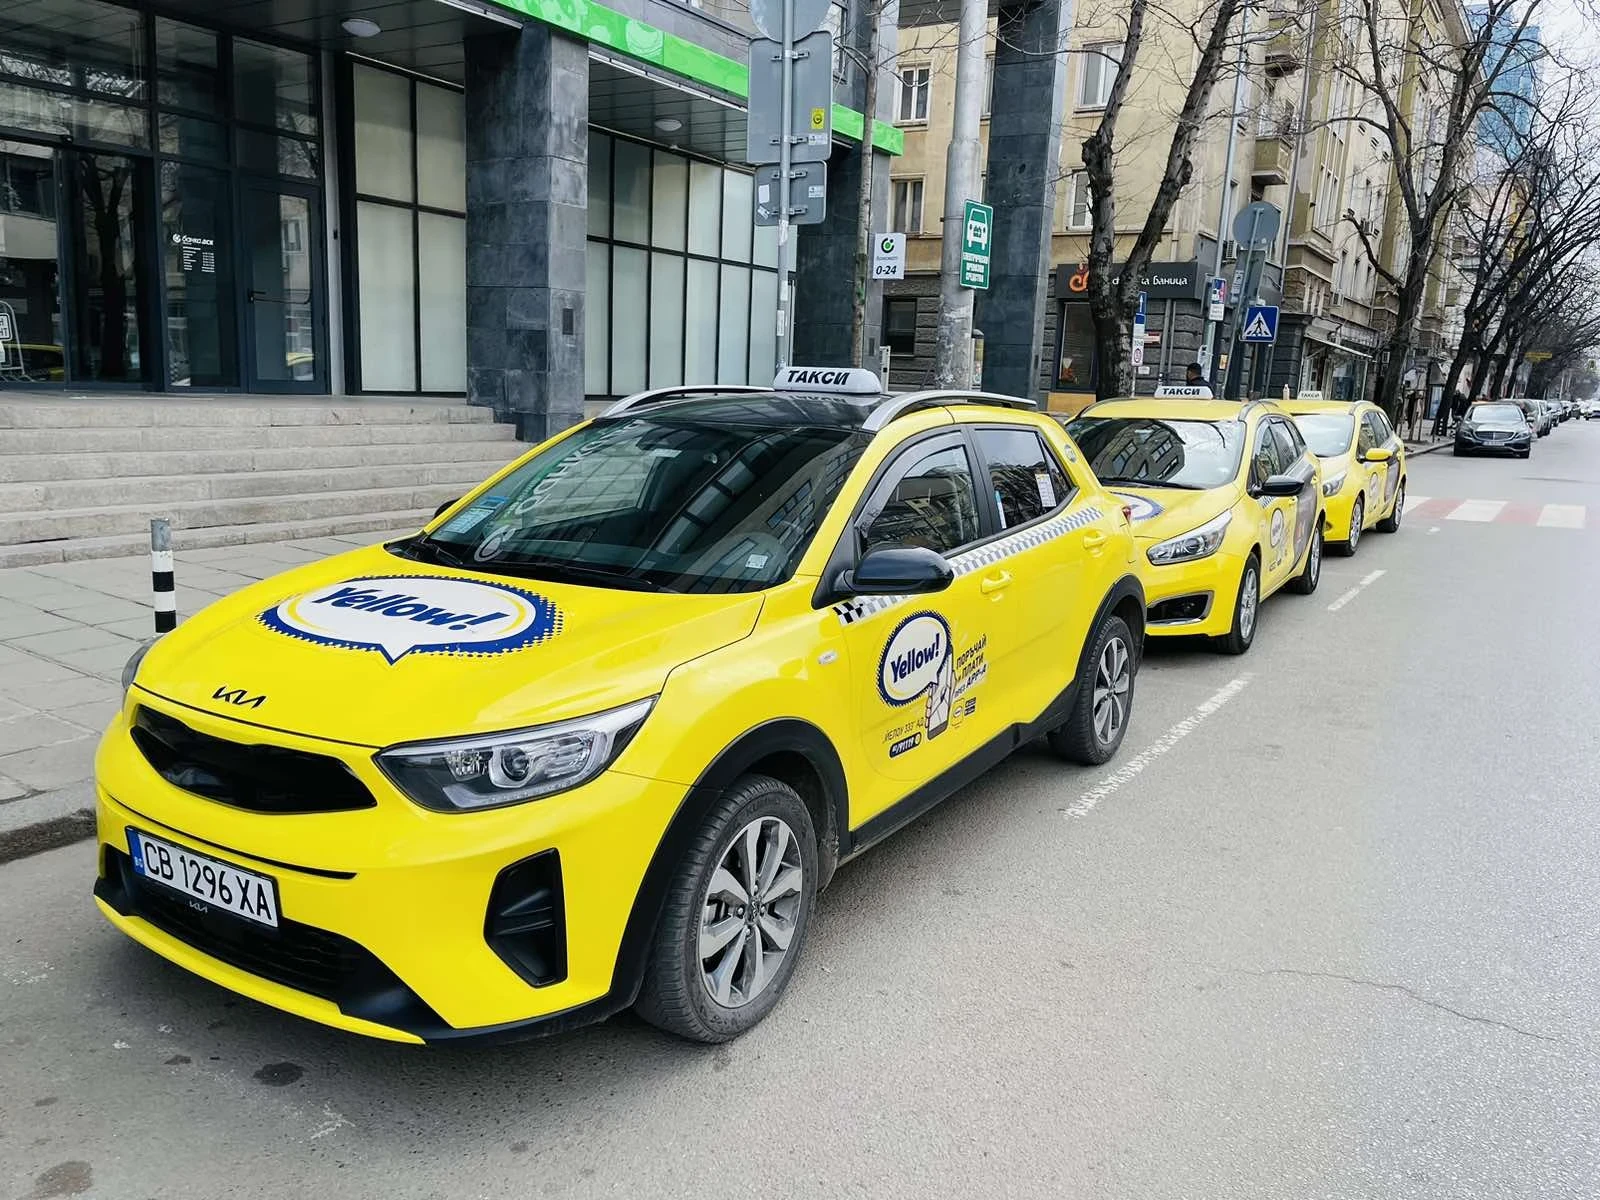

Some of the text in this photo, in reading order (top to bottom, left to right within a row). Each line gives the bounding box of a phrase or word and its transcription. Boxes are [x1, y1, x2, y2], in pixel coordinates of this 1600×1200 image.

[876, 265, 897, 275] 0-24
[787, 369, 850, 386] ТАКСИ
[1163, 388, 1201, 396] ТАКСИ
[312, 586, 511, 632] Yellow!
[891, 633, 940, 683] Yellow!
[144, 841, 272, 920] CB 1296 XA
